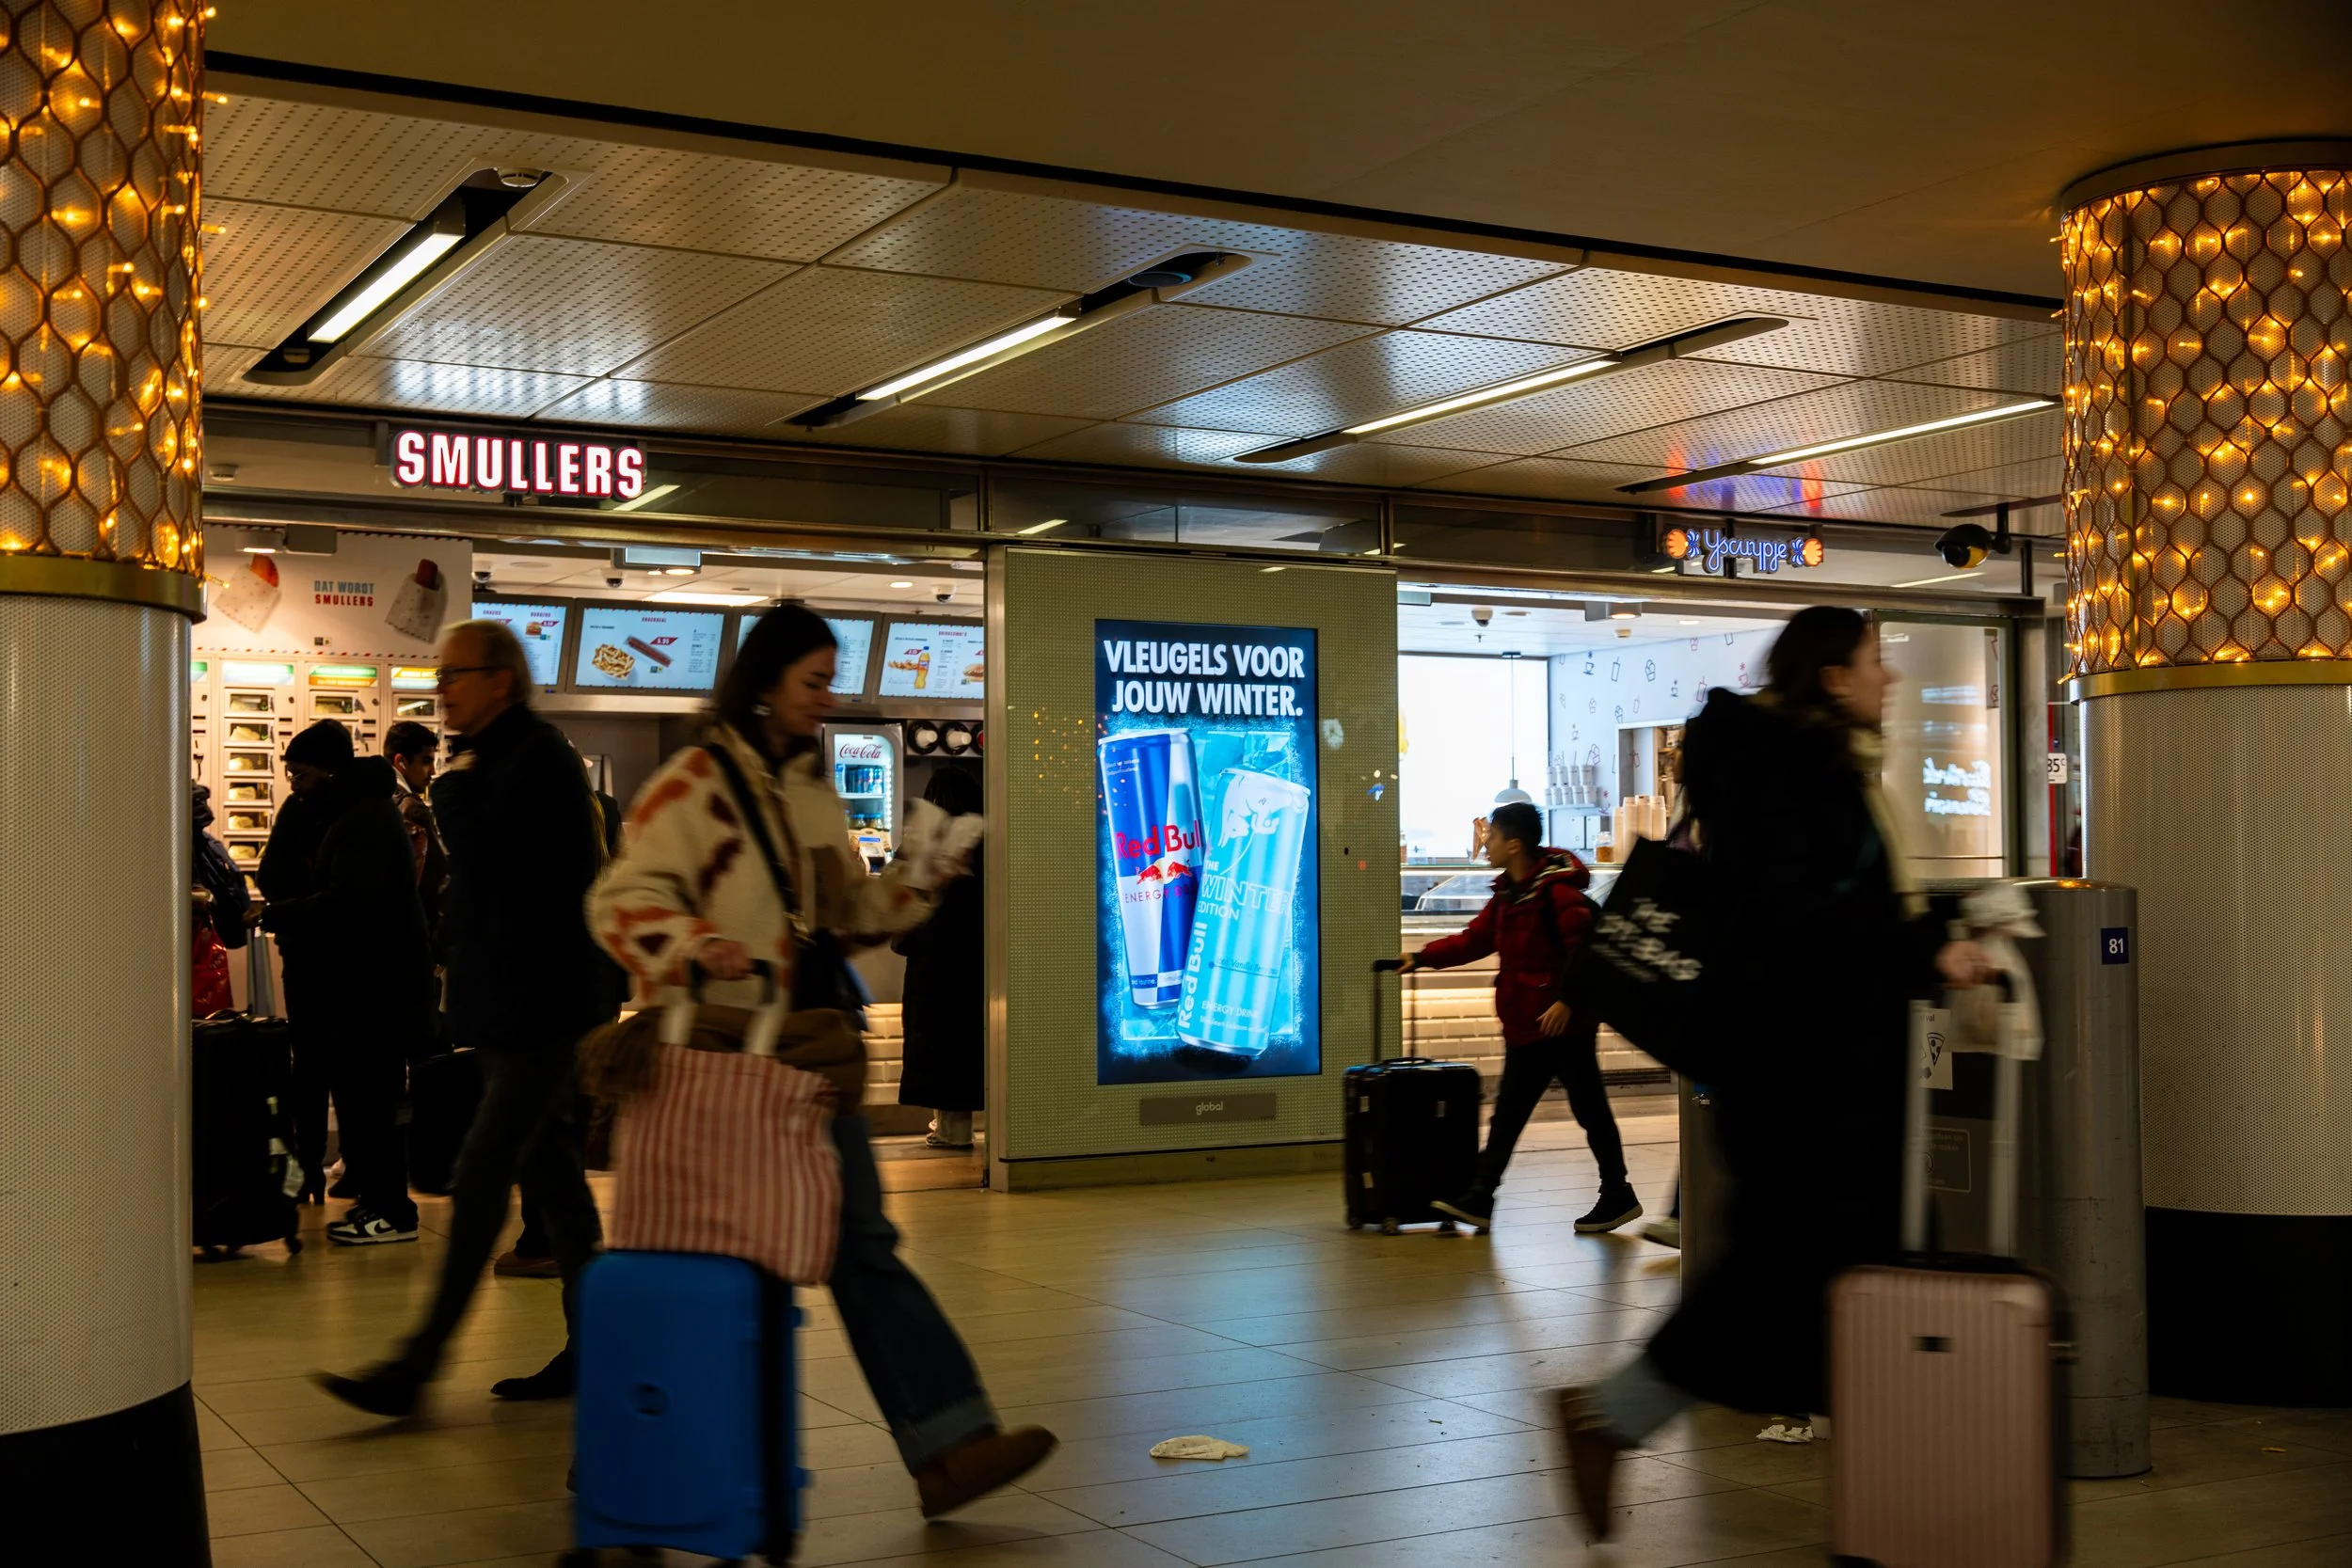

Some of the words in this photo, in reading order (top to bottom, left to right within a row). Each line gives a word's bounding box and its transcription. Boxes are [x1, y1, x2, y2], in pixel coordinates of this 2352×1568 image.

[395, 430, 644, 499] SMULLERS
[314, 579, 333, 593] DAT
[338, 581, 374, 594] WORDT
[315, 594, 373, 607] SMULLERS
[1103, 640, 1227, 676] VLEUGELS
[1232, 644, 1305, 678] VOOR
[1112, 680, 1191, 714] JOUW
[1197, 683, 1303, 717] WINTER.
[1116, 825, 1160, 860] Red
[1163, 819, 1200, 852] Bul
[1204, 860, 1219, 871] THE
[1125, 886, 1169, 904] ENERGY
[1201, 874, 1292, 917] WINTER
[1198, 900, 1240, 920] EDITION
[1187, 922, 1208, 973] Bull
[2108, 938, 2124, 955] 81
[1178, 974, 1199, 1029] Red
[1201, 1000, 1234, 1016] ENERGY
[1196, 1101, 1223, 1116] global
